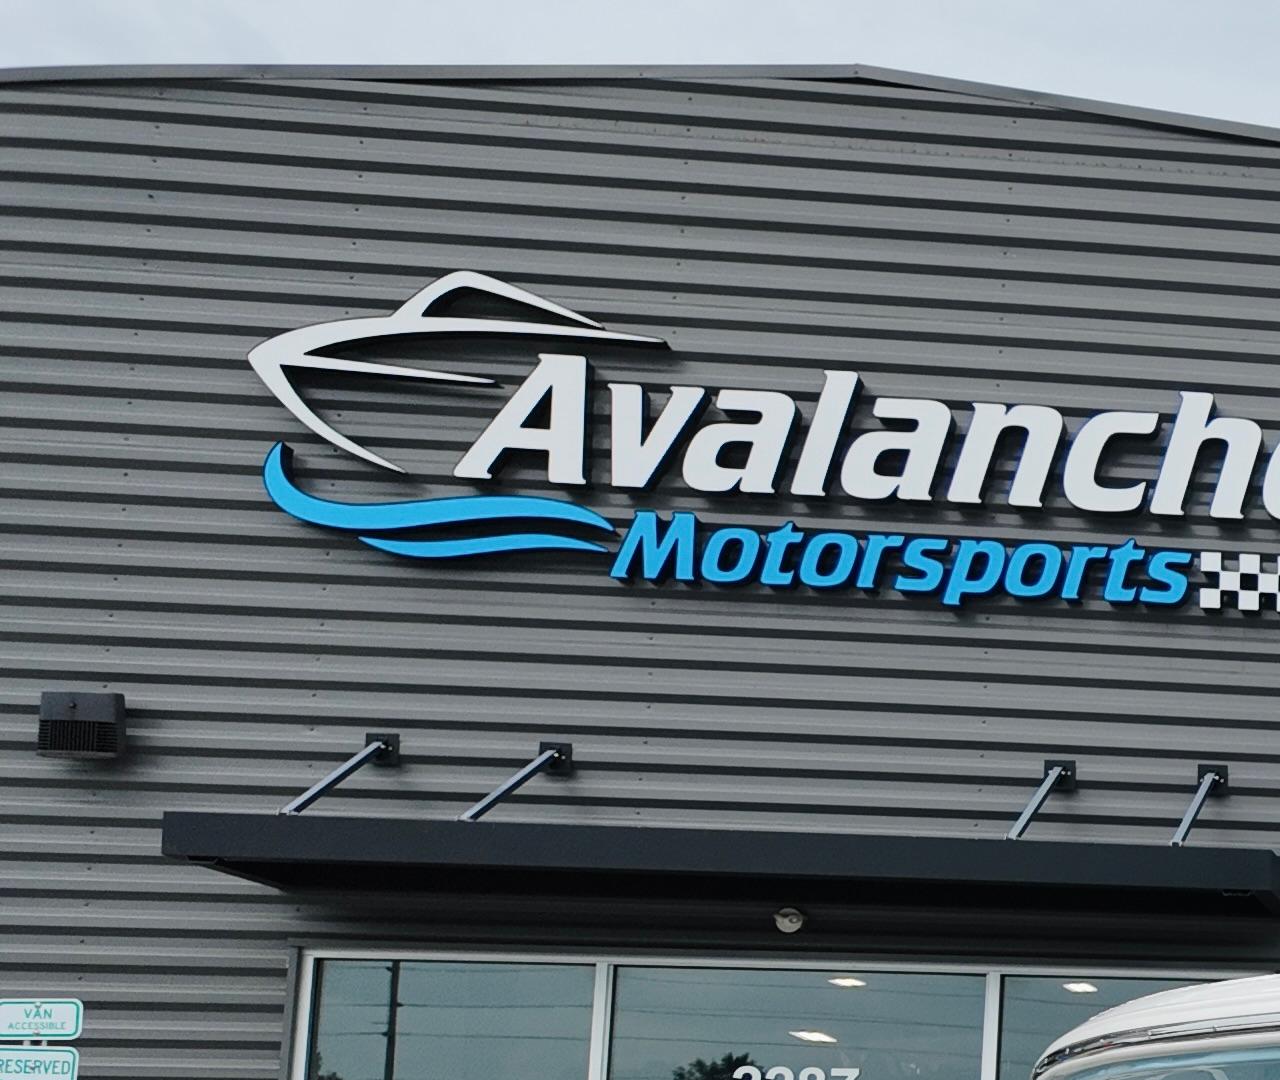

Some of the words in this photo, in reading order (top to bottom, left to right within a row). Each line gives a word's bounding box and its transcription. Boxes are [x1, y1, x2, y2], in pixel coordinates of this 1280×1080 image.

[610, 511, 1199, 605] Motorsports
[24, 1008, 53, 1019] VAN
[8, 1021, 67, 1030] ACCESSIBLE
